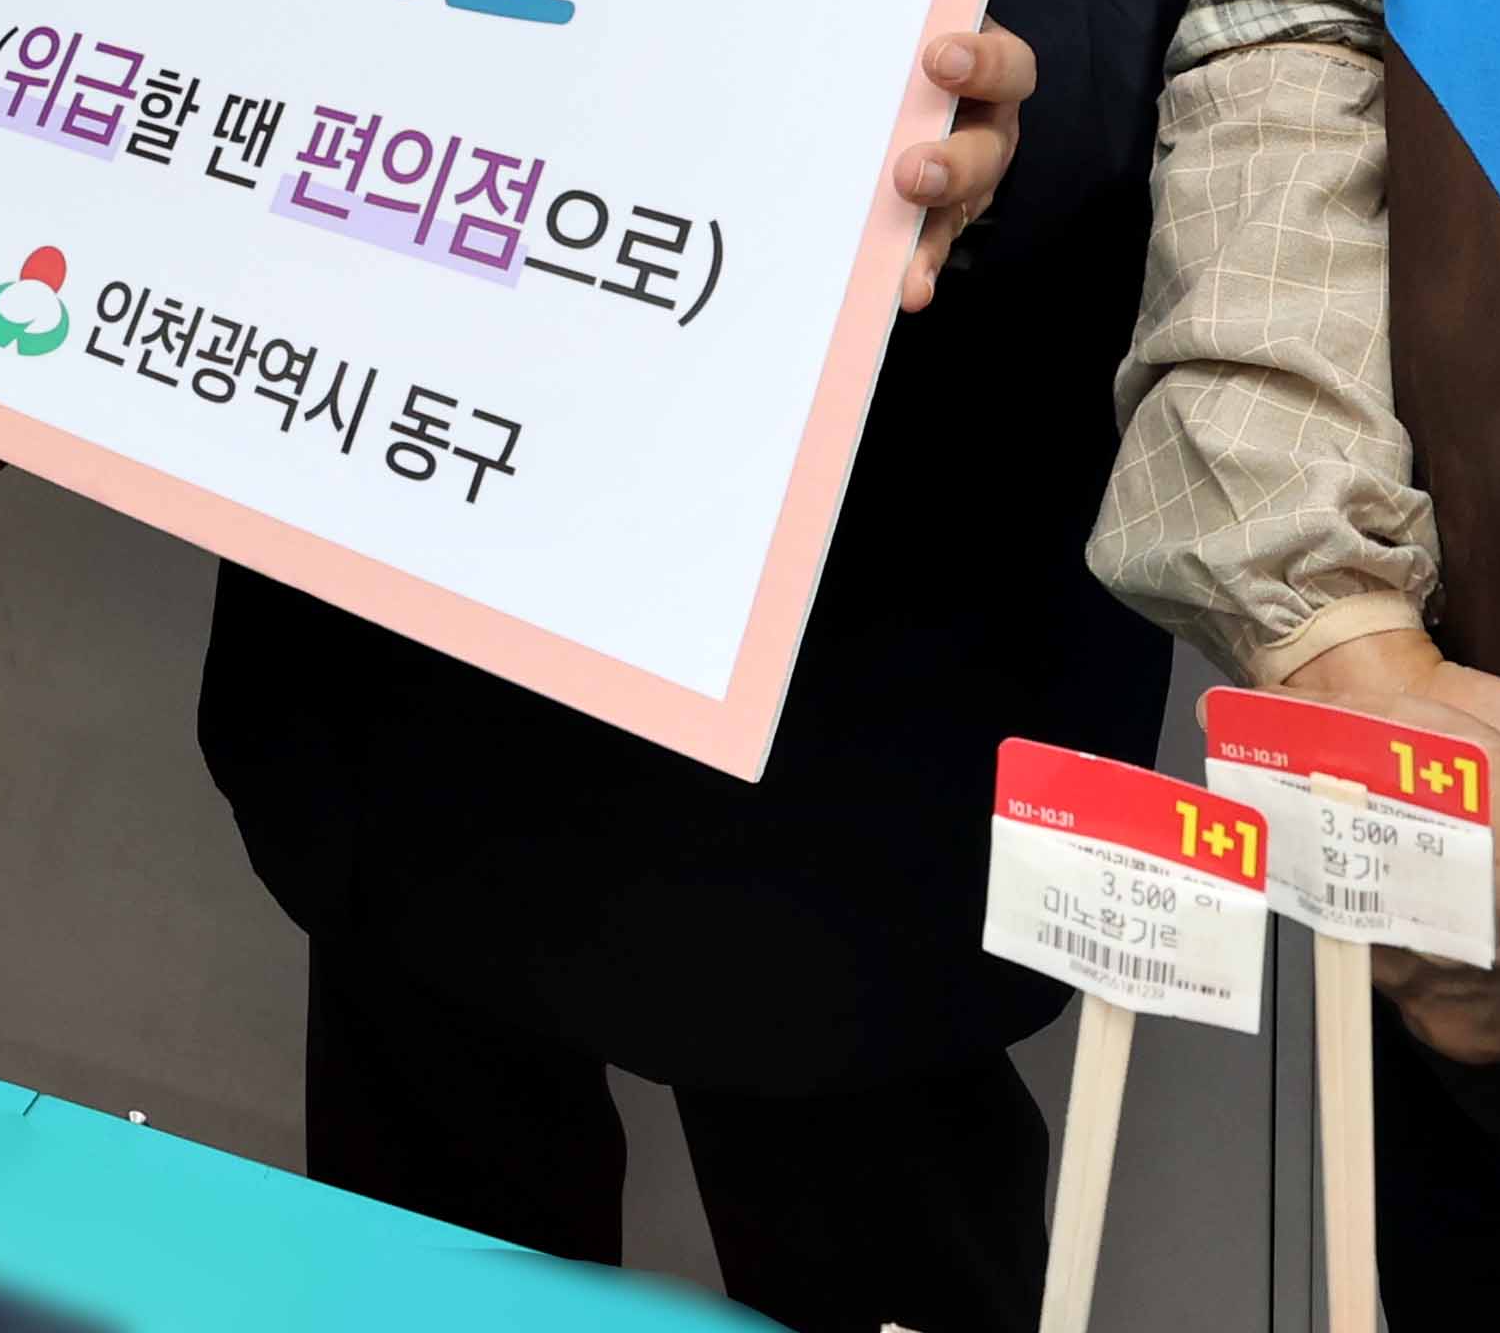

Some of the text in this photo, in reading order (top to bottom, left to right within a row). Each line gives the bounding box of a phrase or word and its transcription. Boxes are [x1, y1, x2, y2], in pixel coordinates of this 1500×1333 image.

[205, 94, 285, 189] 땐
[291, 105, 725, 328] 편의점으로)
[85, 280, 523, 505] 인천광역시 동구
[1389, 740, 1479, 814] 1+1
[1175, 799, 1260, 879] 1+1
[1321, 808, 1398, 846] 3,500
[1102, 870, 1177, 915] 3,500
